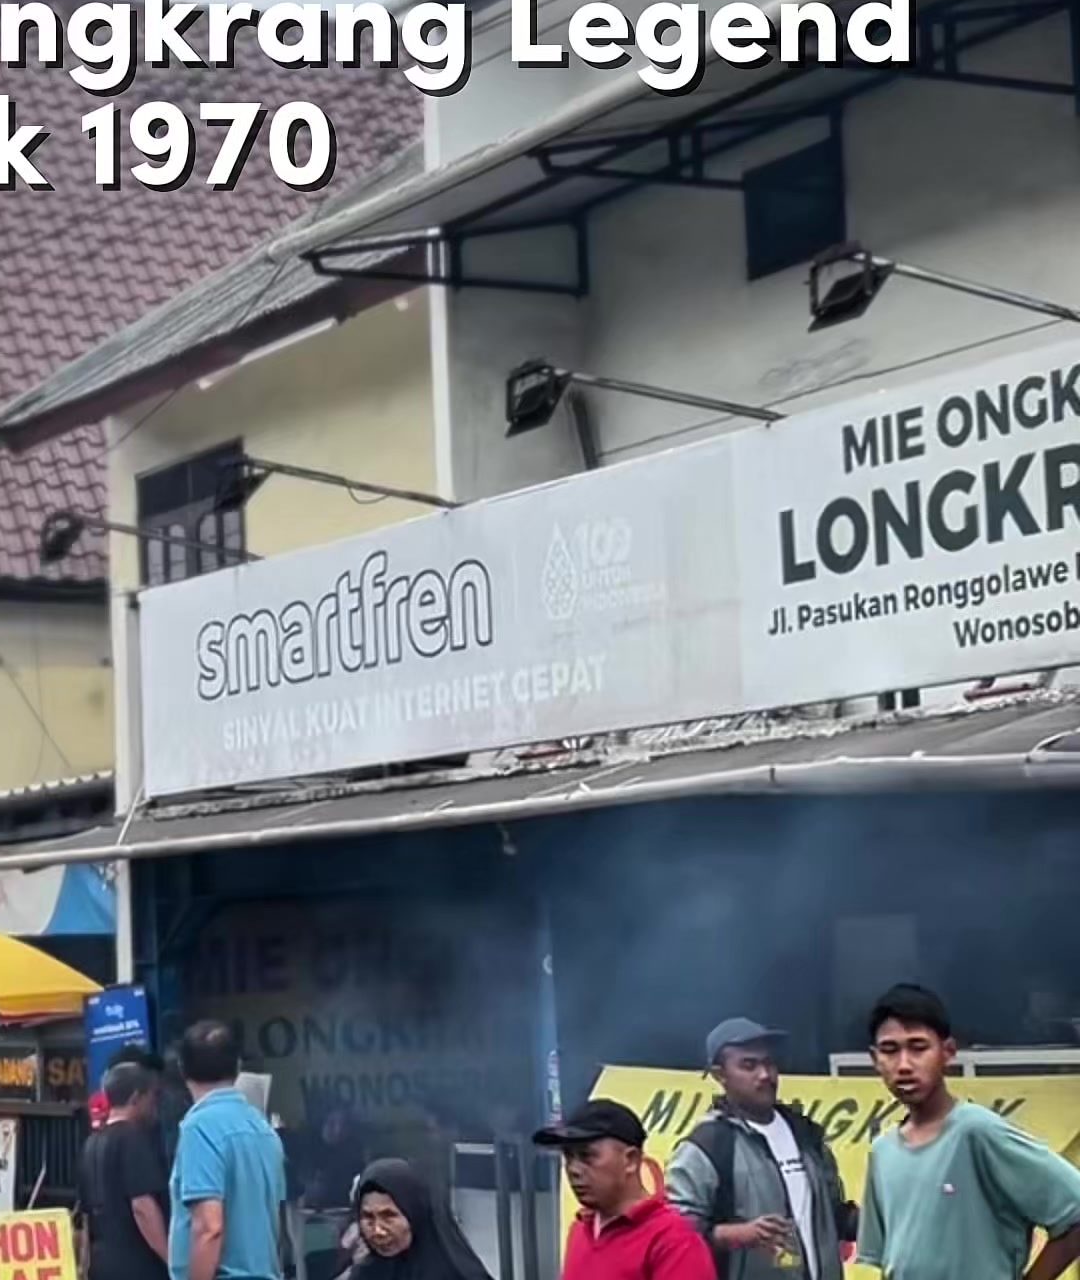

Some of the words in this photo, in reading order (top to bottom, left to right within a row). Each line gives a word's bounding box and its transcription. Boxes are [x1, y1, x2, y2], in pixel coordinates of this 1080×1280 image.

[841, 404, 926, 475] MIE
[197, 549, 493, 701] smartfren
[797, 592, 898, 631] Pasukan
[904, 560, 1069, 612] Ronggolawe
[222, 710, 300, 752] SINYAL
[306, 694, 371, 736] KUAT
[374, 671, 505, 725] INTERNET
[512, 654, 610, 704] CEPAT
[47, 1056, 87, 1087] SA
